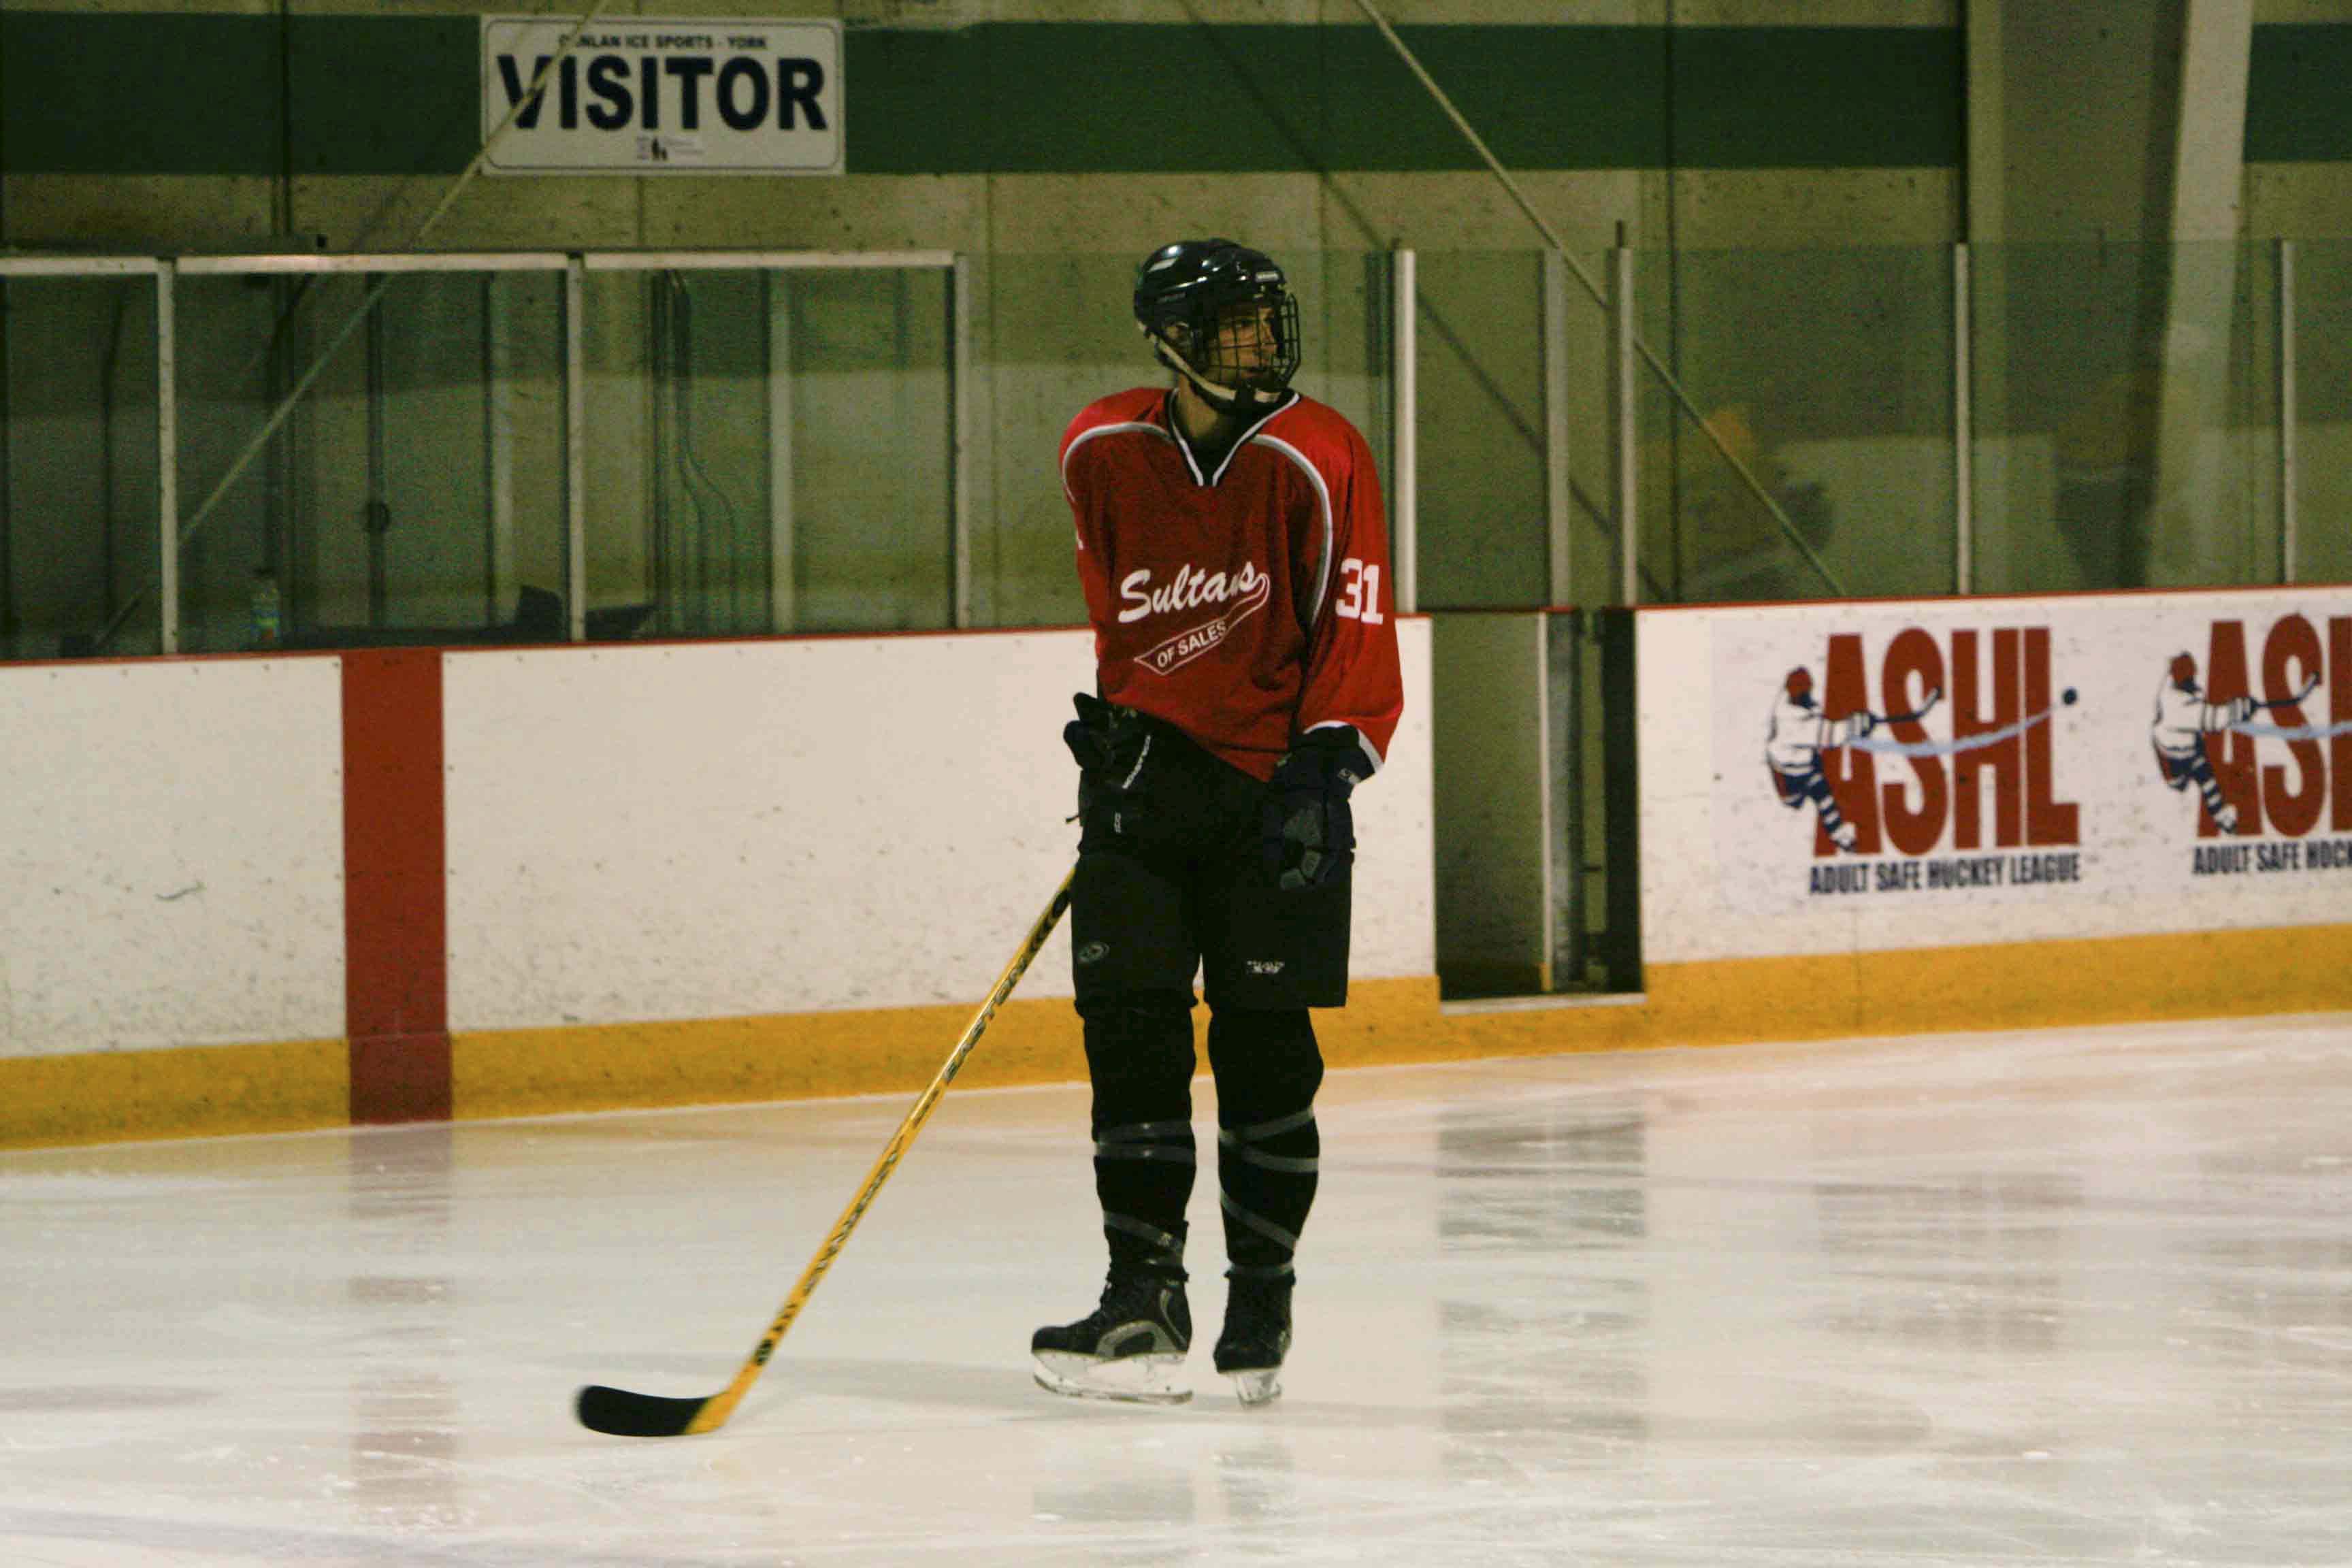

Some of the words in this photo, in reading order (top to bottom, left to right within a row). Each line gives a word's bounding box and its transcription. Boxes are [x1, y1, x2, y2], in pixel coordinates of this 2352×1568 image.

[559, 33, 621, 48] CNLAN
[625, 34, 649, 48] ICE
[655, 34, 713, 50] SPORTS
[727, 35, 767, 50] YORK
[497, 54, 827, 131] VISITOR
[1335, 557, 1384, 625] 31
[1157, 647, 1176, 668] OF
[1178, 620, 1228, 657] SALES
[1813, 626, 2079, 857] ASHL
[1810, 863, 1870, 894] ADULT
[1876, 860, 1922, 891] SAFE
[1927, 855, 2004, 889] HOCKEY
[2010, 853, 2080, 885] LEAGUE
[2193, 844, 2250, 875] ADULT
[2256, 841, 2299, 872] SAFE
